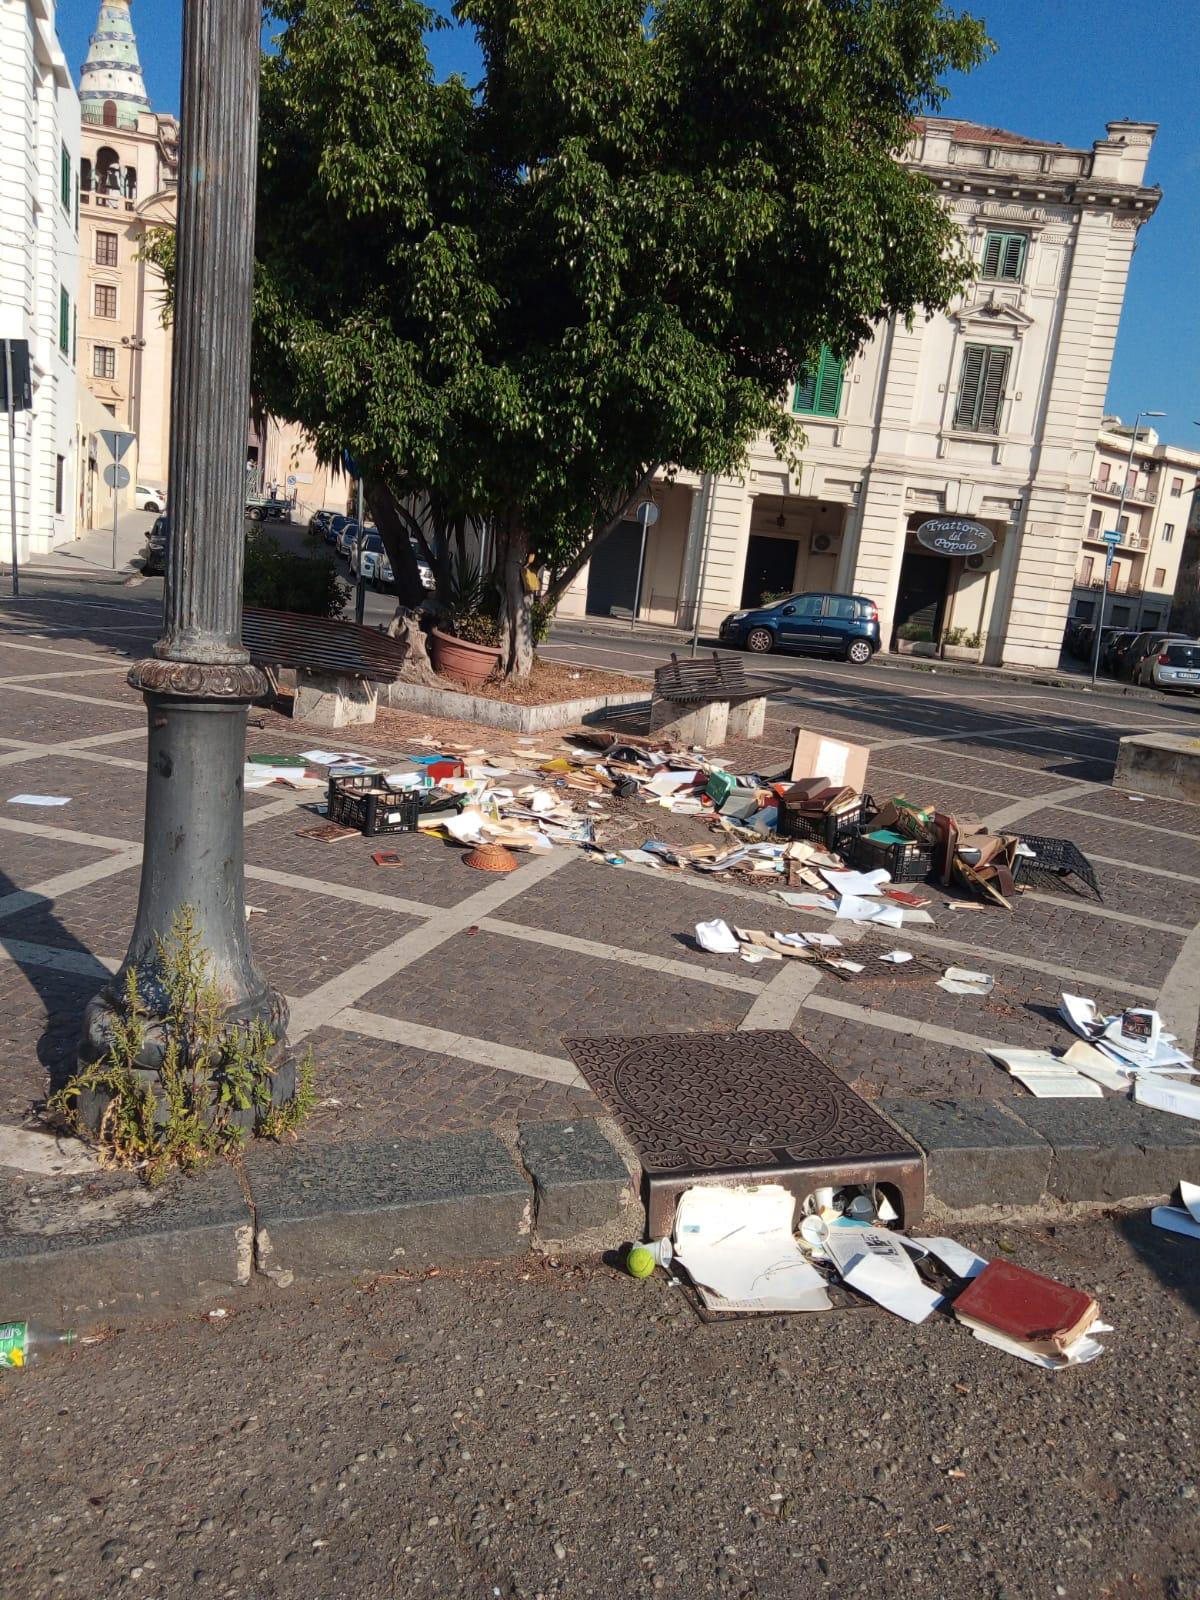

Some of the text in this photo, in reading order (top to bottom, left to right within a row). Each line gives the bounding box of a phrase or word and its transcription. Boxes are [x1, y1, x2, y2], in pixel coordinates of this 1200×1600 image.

[926, 519, 987, 539] Trattoria
[948, 531, 962, 541] del
[934, 538, 977, 552] Popolo
